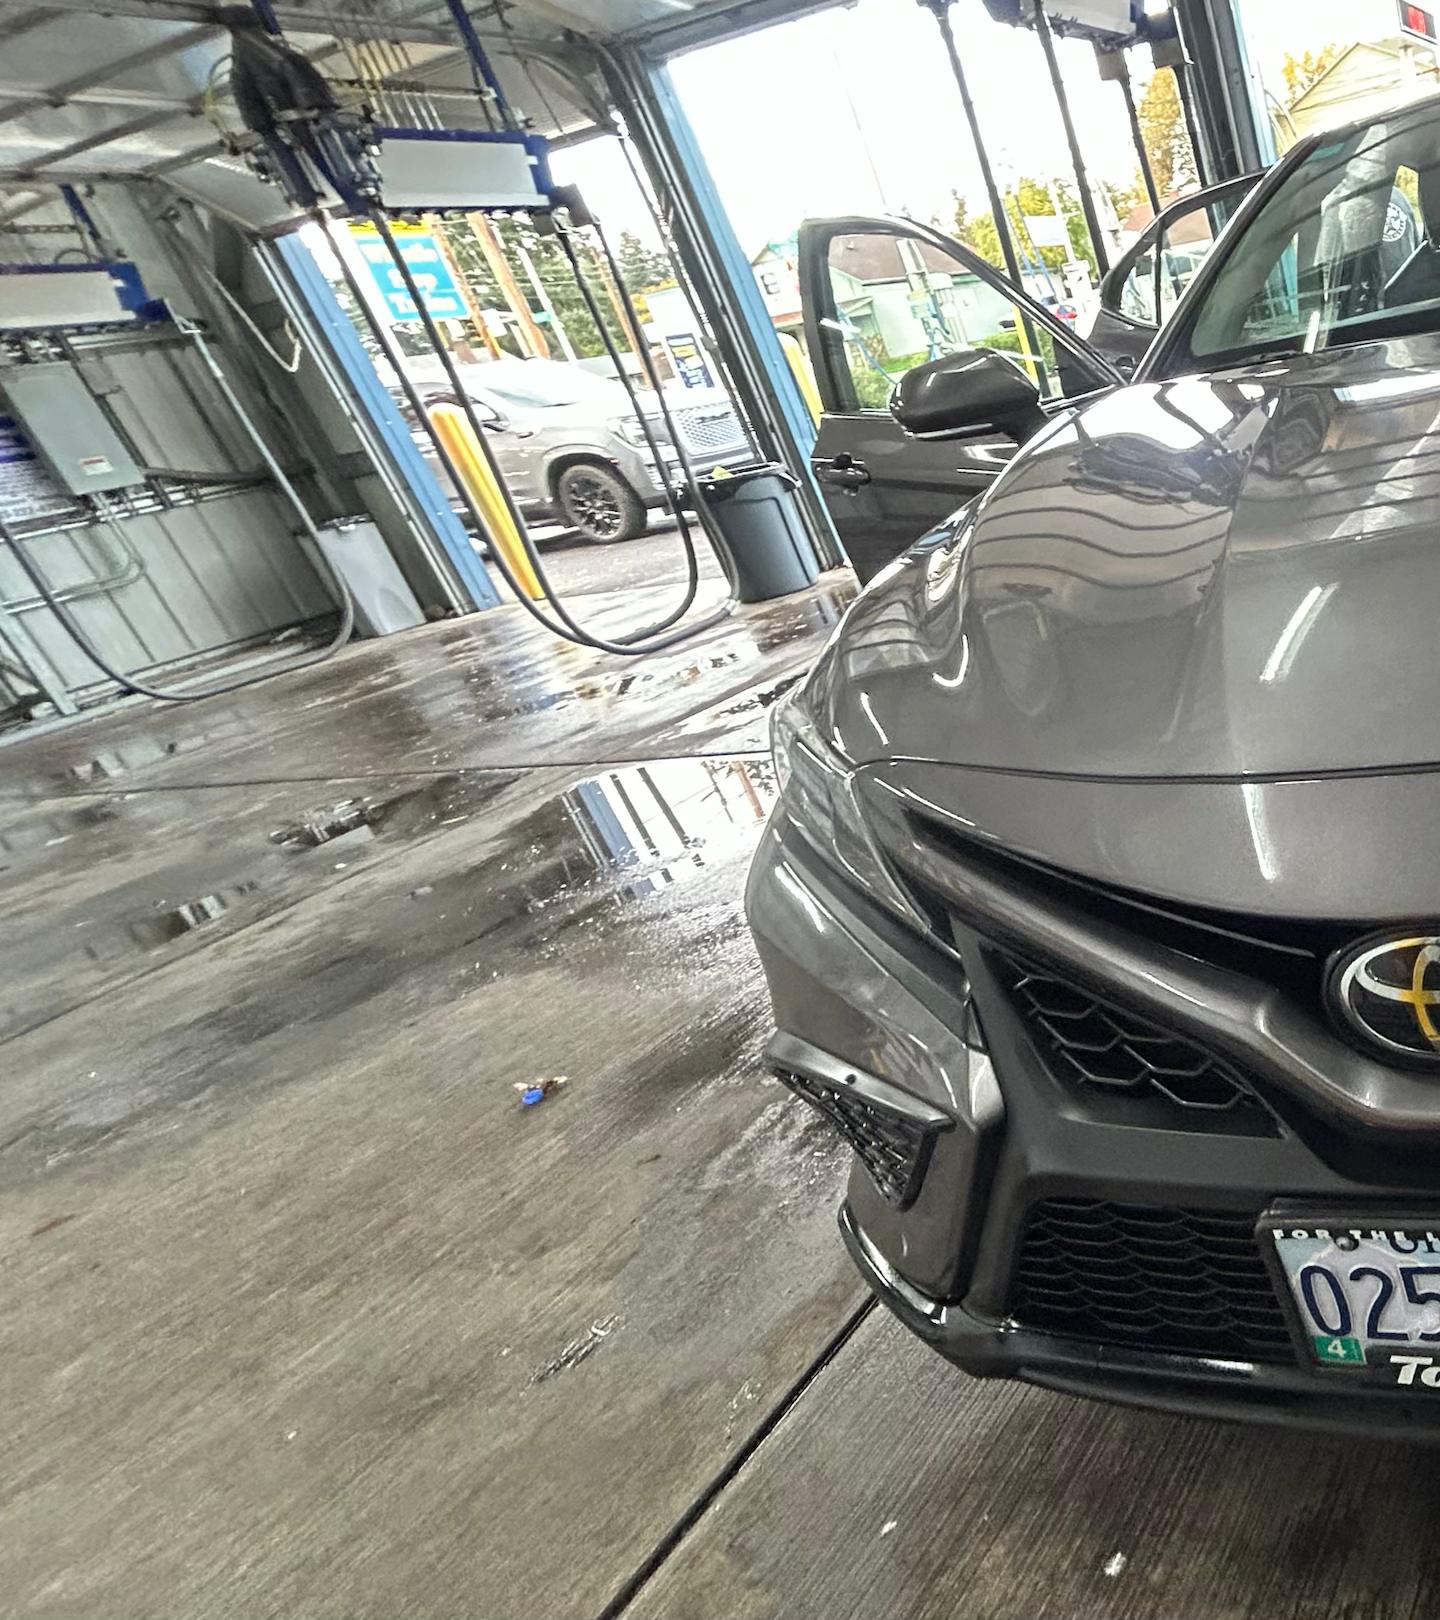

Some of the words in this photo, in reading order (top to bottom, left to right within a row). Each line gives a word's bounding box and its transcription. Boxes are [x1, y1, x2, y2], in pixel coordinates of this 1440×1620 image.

[1272, 1228, 1332, 1240] FOR
[1349, 1229, 1409, 1242] THE
[1327, 1339, 1347, 1358] 4
